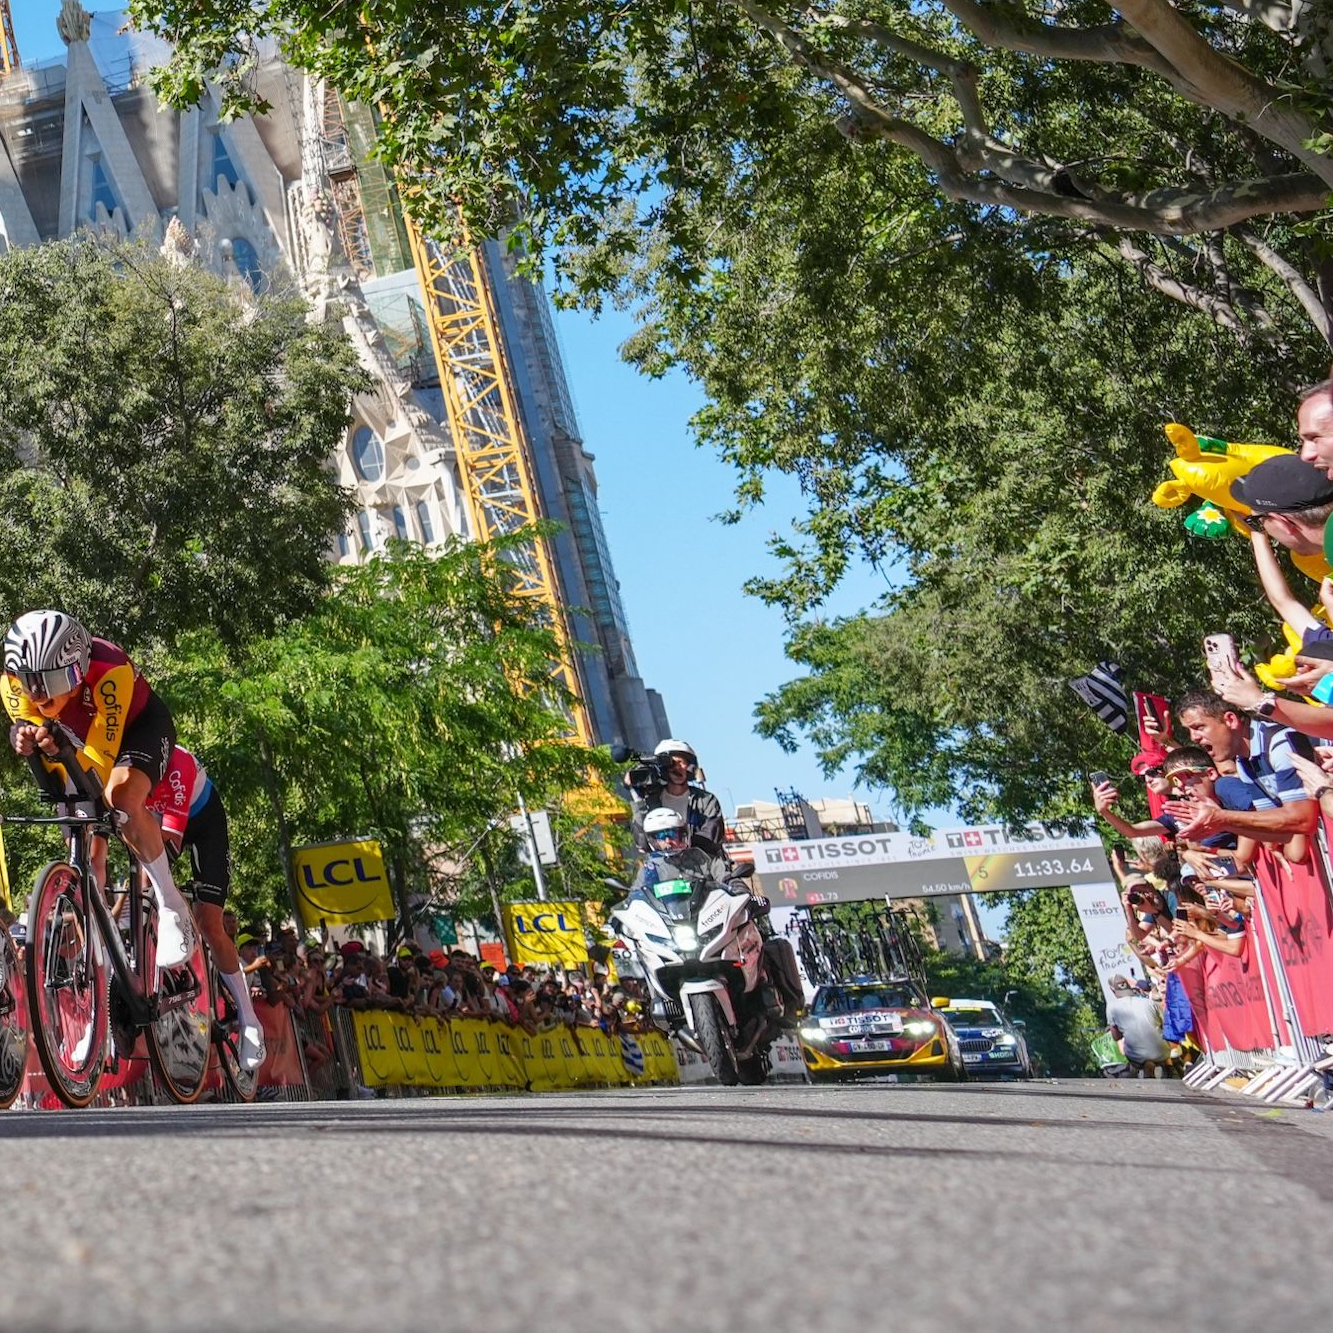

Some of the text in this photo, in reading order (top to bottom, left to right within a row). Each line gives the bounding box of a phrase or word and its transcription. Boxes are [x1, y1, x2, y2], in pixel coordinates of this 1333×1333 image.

[100, 680, 119, 742] Cofidis
[801, 839, 891, 860] TISSOT
[302, 857, 381, 889] LCL
[803, 871, 839, 881] COFIDIS
[979, 858, 1094, 879] 5 11:33.64
[1082, 907, 1119, 916] TISSOT
[516, 912, 579, 935] LCL
[168, 995, 181, 1004] 796
[847, 1015, 889, 1025] TISSOT
[363, 1024, 386, 1051] LCL
[393, 1026, 415, 1052] LCL
[421, 1029, 441, 1054] LCL
